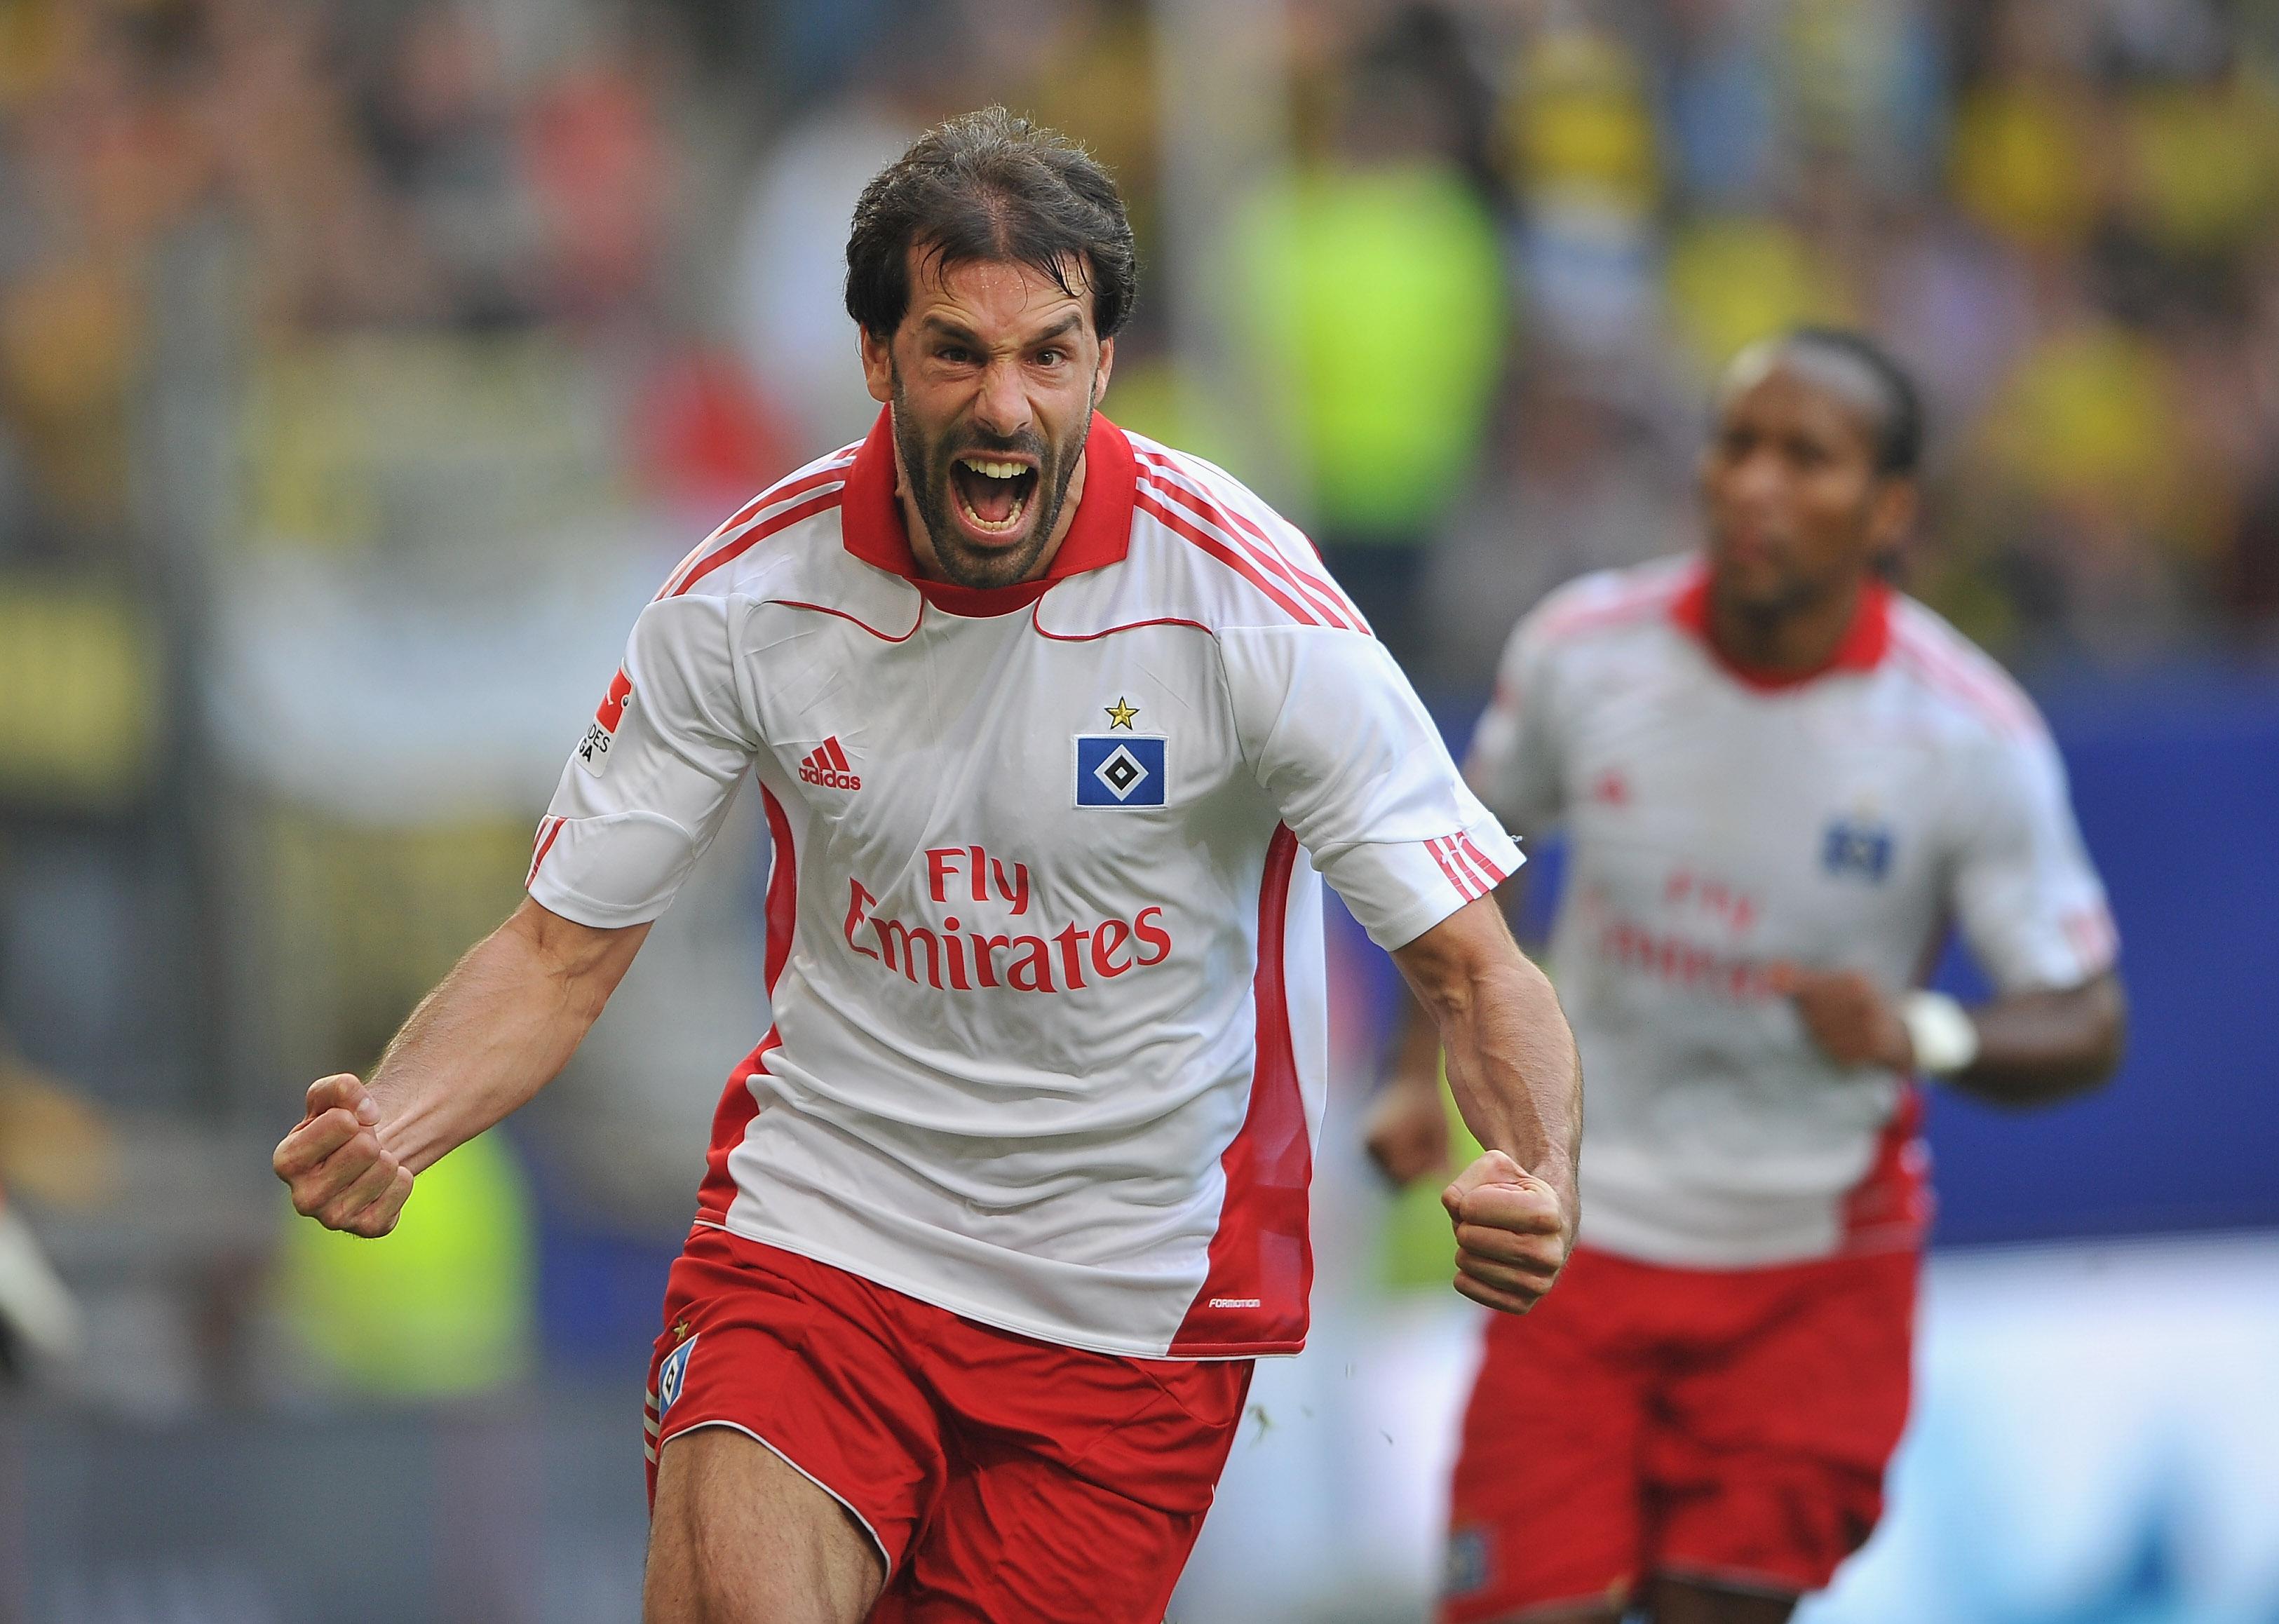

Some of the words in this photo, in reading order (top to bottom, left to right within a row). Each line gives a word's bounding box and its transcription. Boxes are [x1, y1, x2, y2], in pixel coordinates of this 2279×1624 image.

[587, 723, 610, 752] DES
[799, 767, 861, 790] adidas
[925, 845, 1029, 914] Fly
[844, 876, 1172, 993] Emirates
